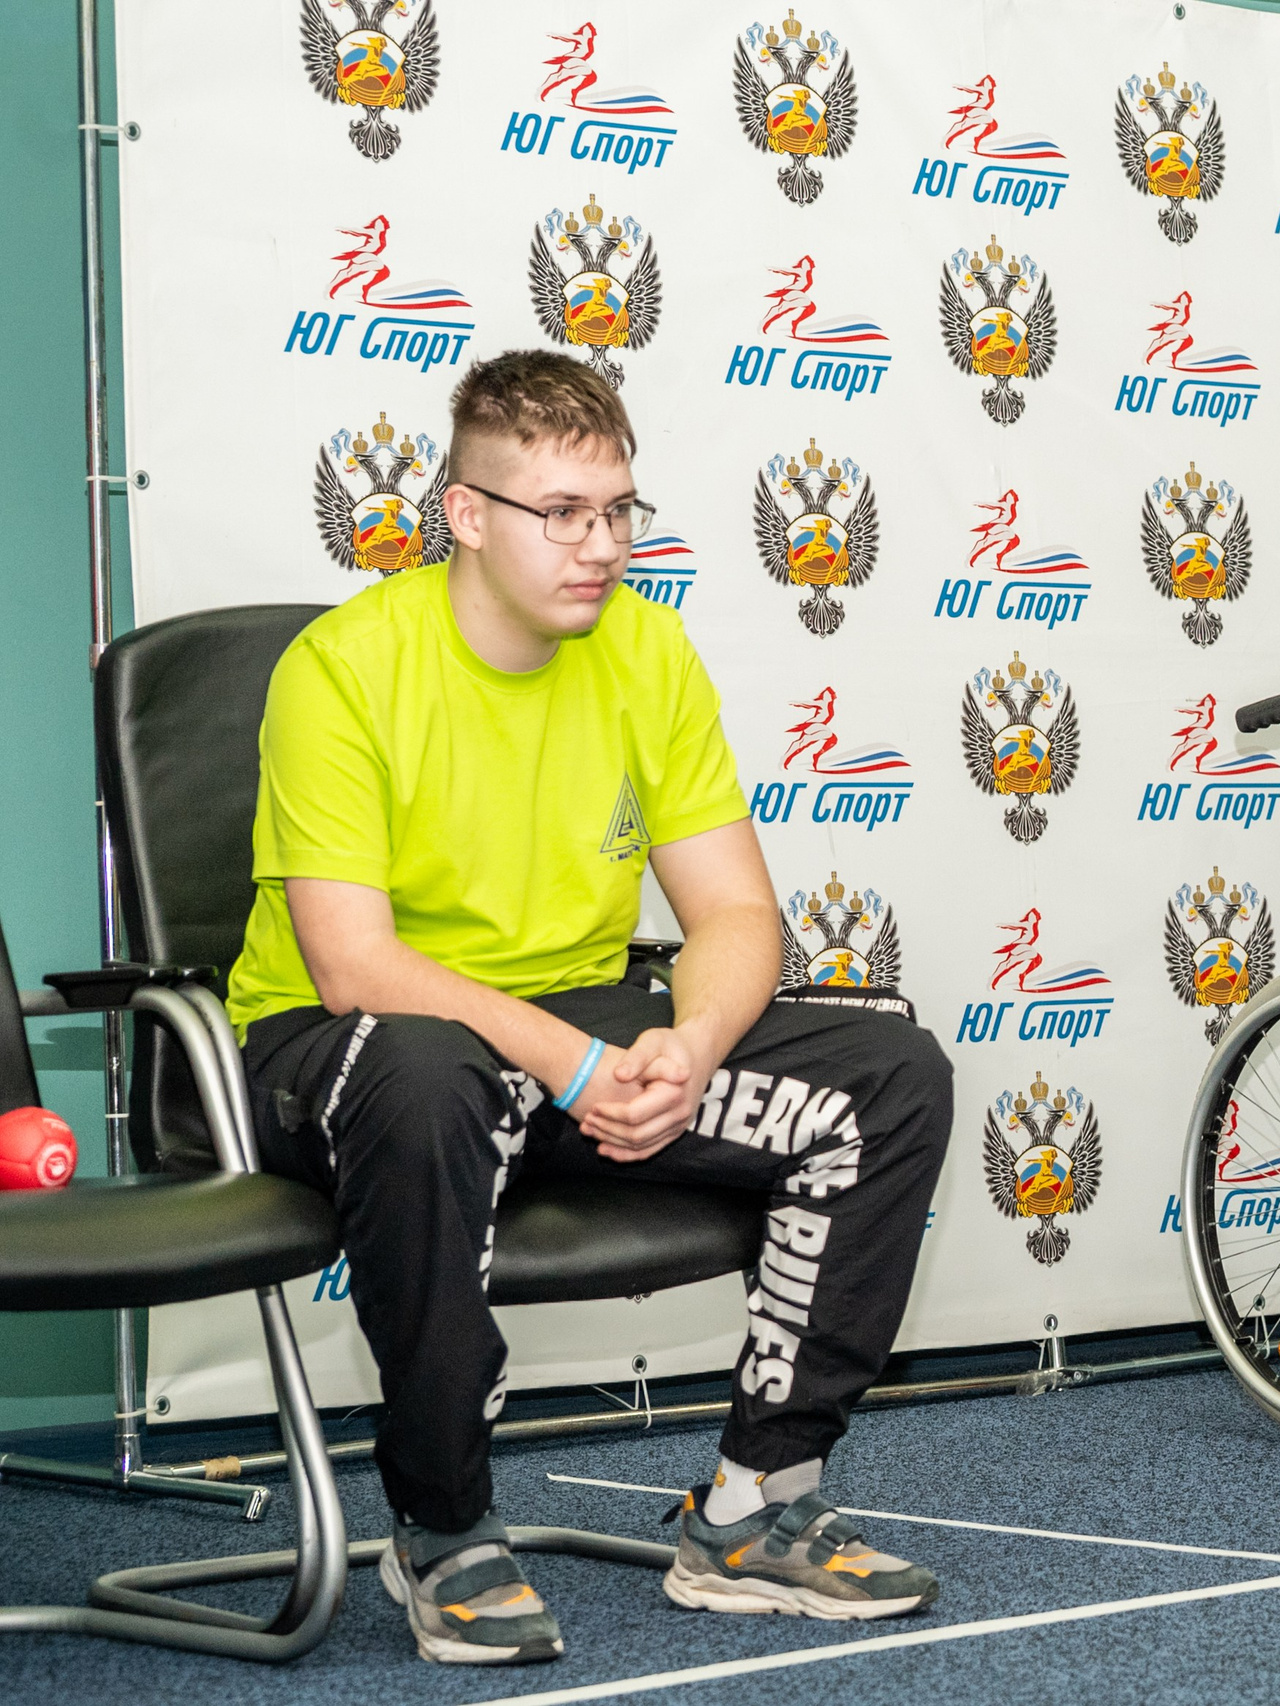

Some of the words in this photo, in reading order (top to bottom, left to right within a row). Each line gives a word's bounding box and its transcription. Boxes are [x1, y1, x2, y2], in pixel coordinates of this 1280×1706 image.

[501, 112, 565, 155] ЮГ
[571, 121, 678, 175] Спорт
[913, 158, 967, 198] ЮГ
[973, 166, 1070, 215] Спорт
[285, 312, 355, 356] ЮГ
[360, 317, 475, 373] Спорт
[726, 346, 786, 386] ЮГ
[791, 351, 892, 402] Спорт
[1115, 376, 1167, 413] ЮГ
[1172, 380, 1261, 428] Спорт
[935, 580, 991, 618] ЮГ
[997, 582, 1092, 630] Спорт
[750, 783, 808, 823] ЮГ
[812, 782, 914, 832] Спорт
[1138, 783, 1191, 821] ЮГ
[957, 1002, 1014, 1042] ЮГ
[1018, 998, 1114, 1048] Спорт
[687, 1068, 852, 1155] REAK
